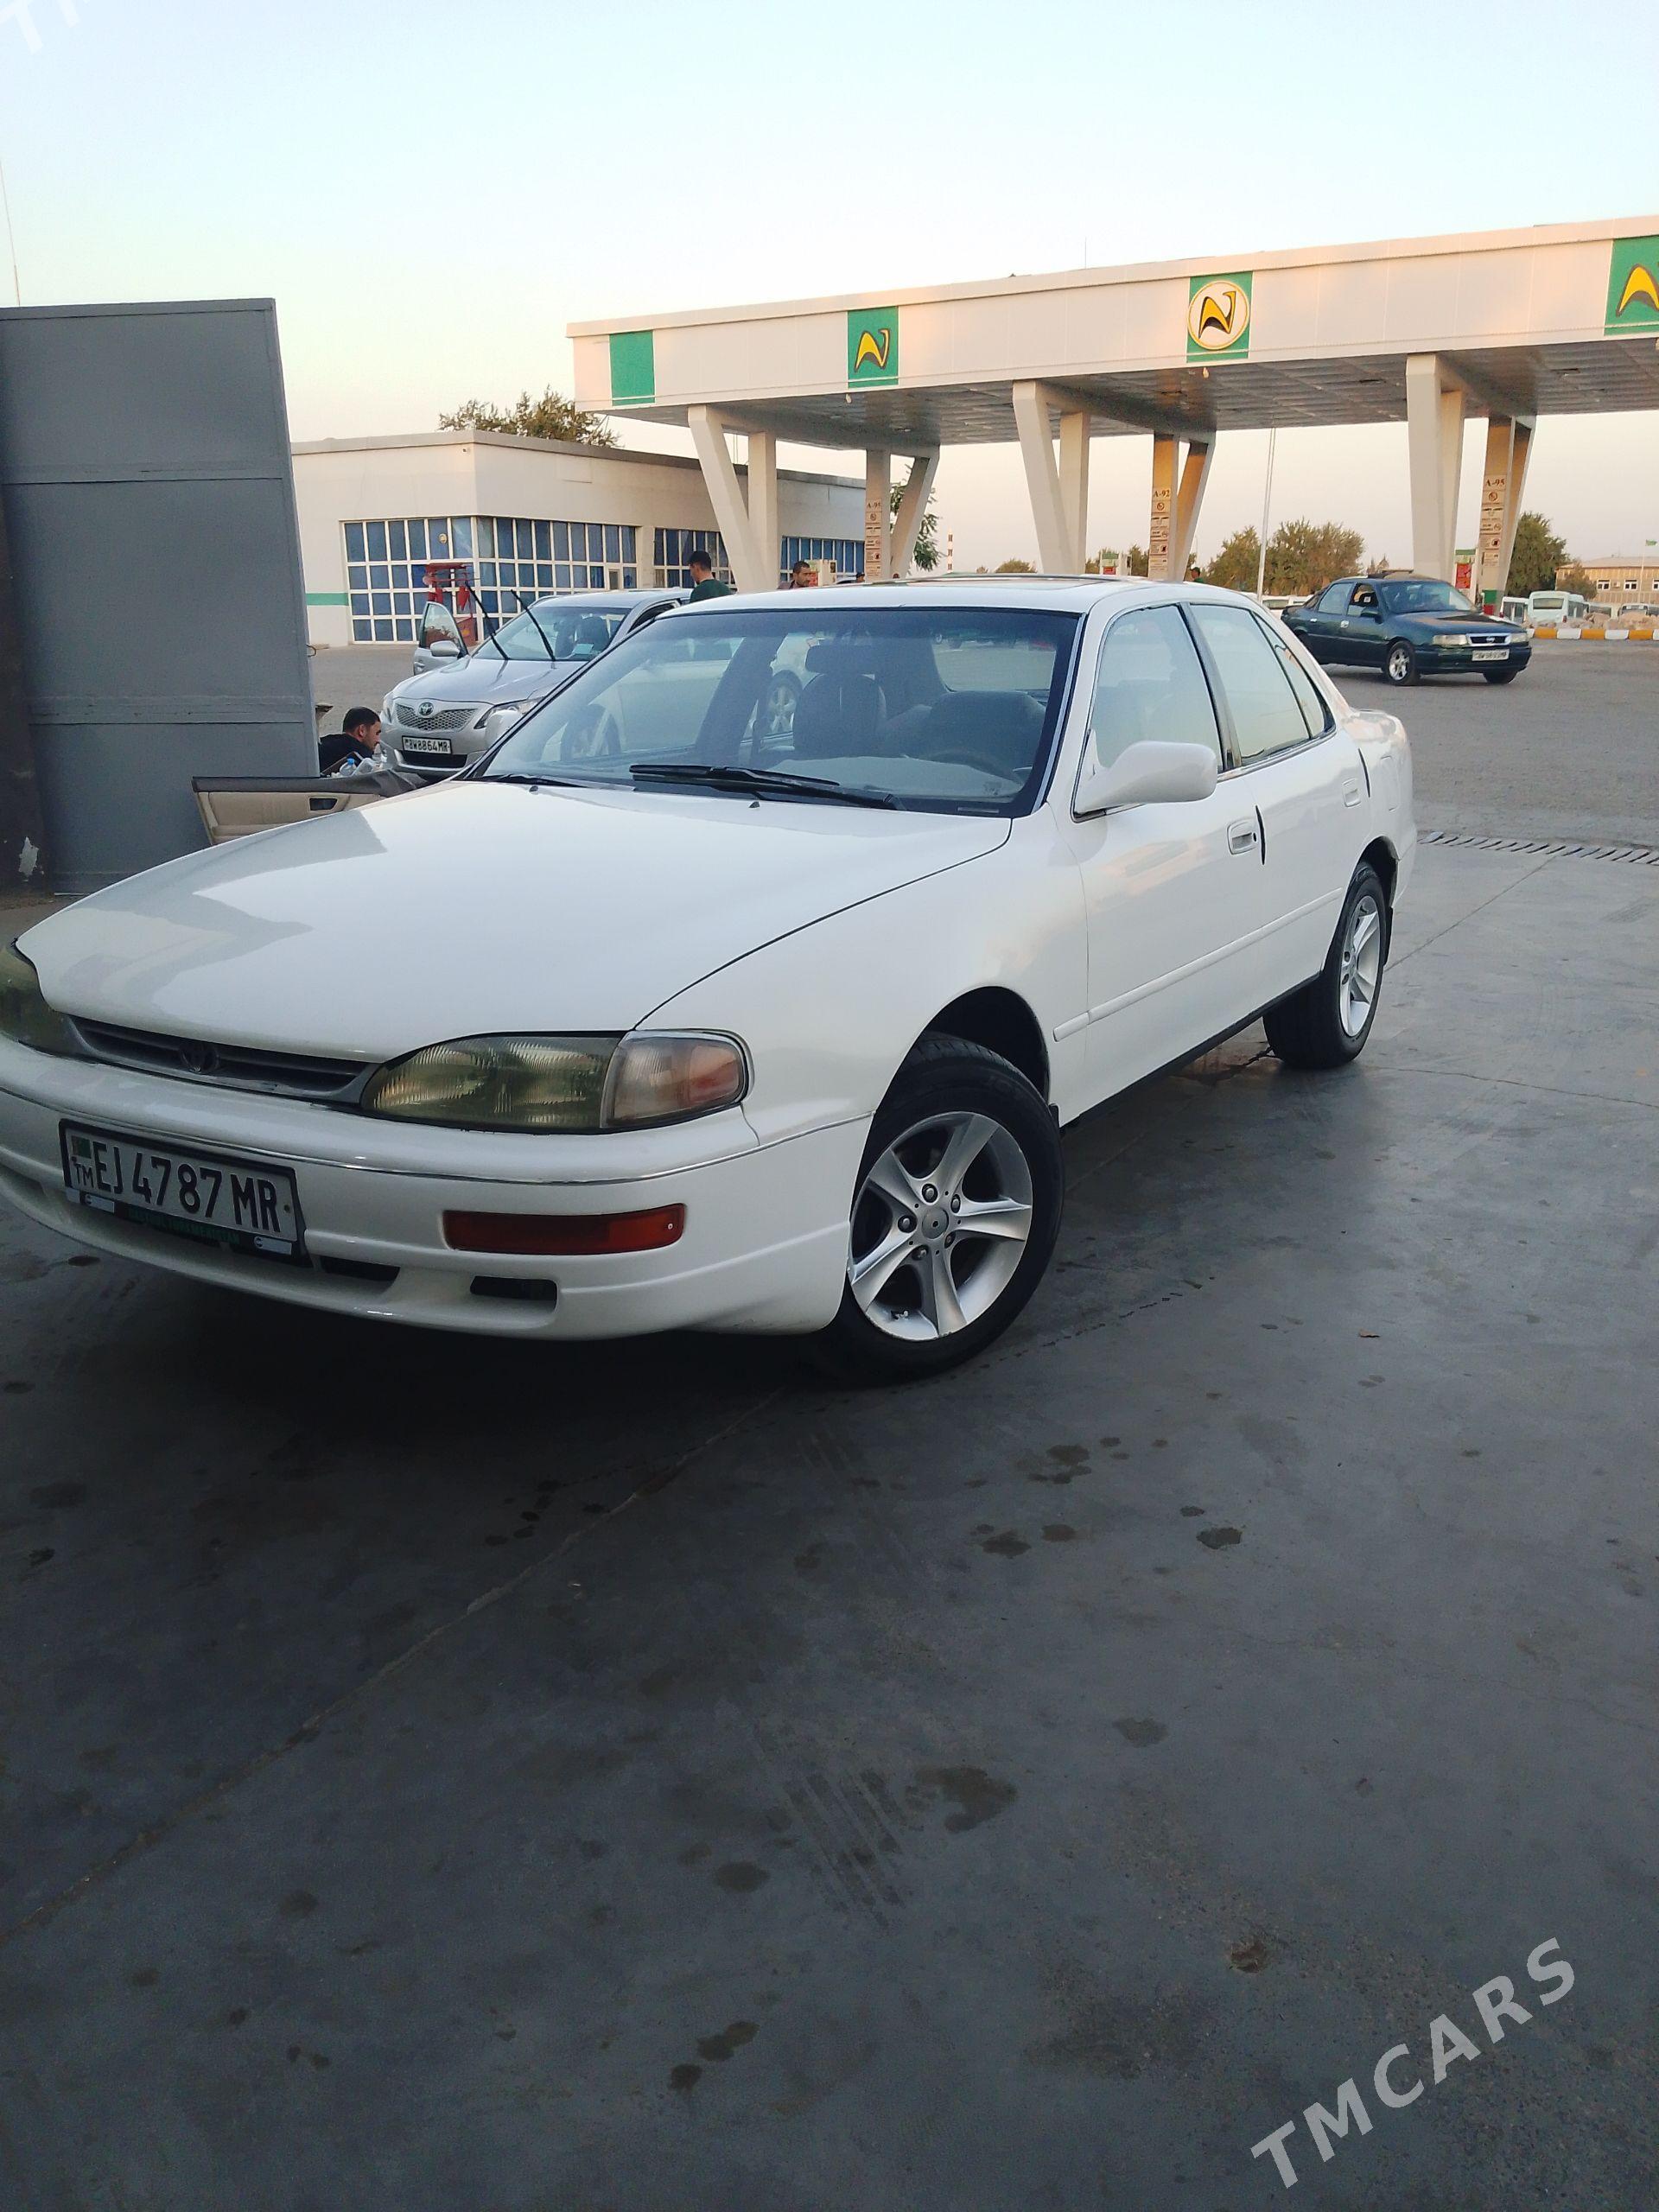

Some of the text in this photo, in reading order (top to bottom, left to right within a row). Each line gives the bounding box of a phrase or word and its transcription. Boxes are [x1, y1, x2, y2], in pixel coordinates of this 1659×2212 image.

[1154, 489, 1170, 498] A-92
[75, 1166, 94, 1189] TM
[132, 1151, 222, 1218] 4787
[230, 1173, 281, 1233] MR
